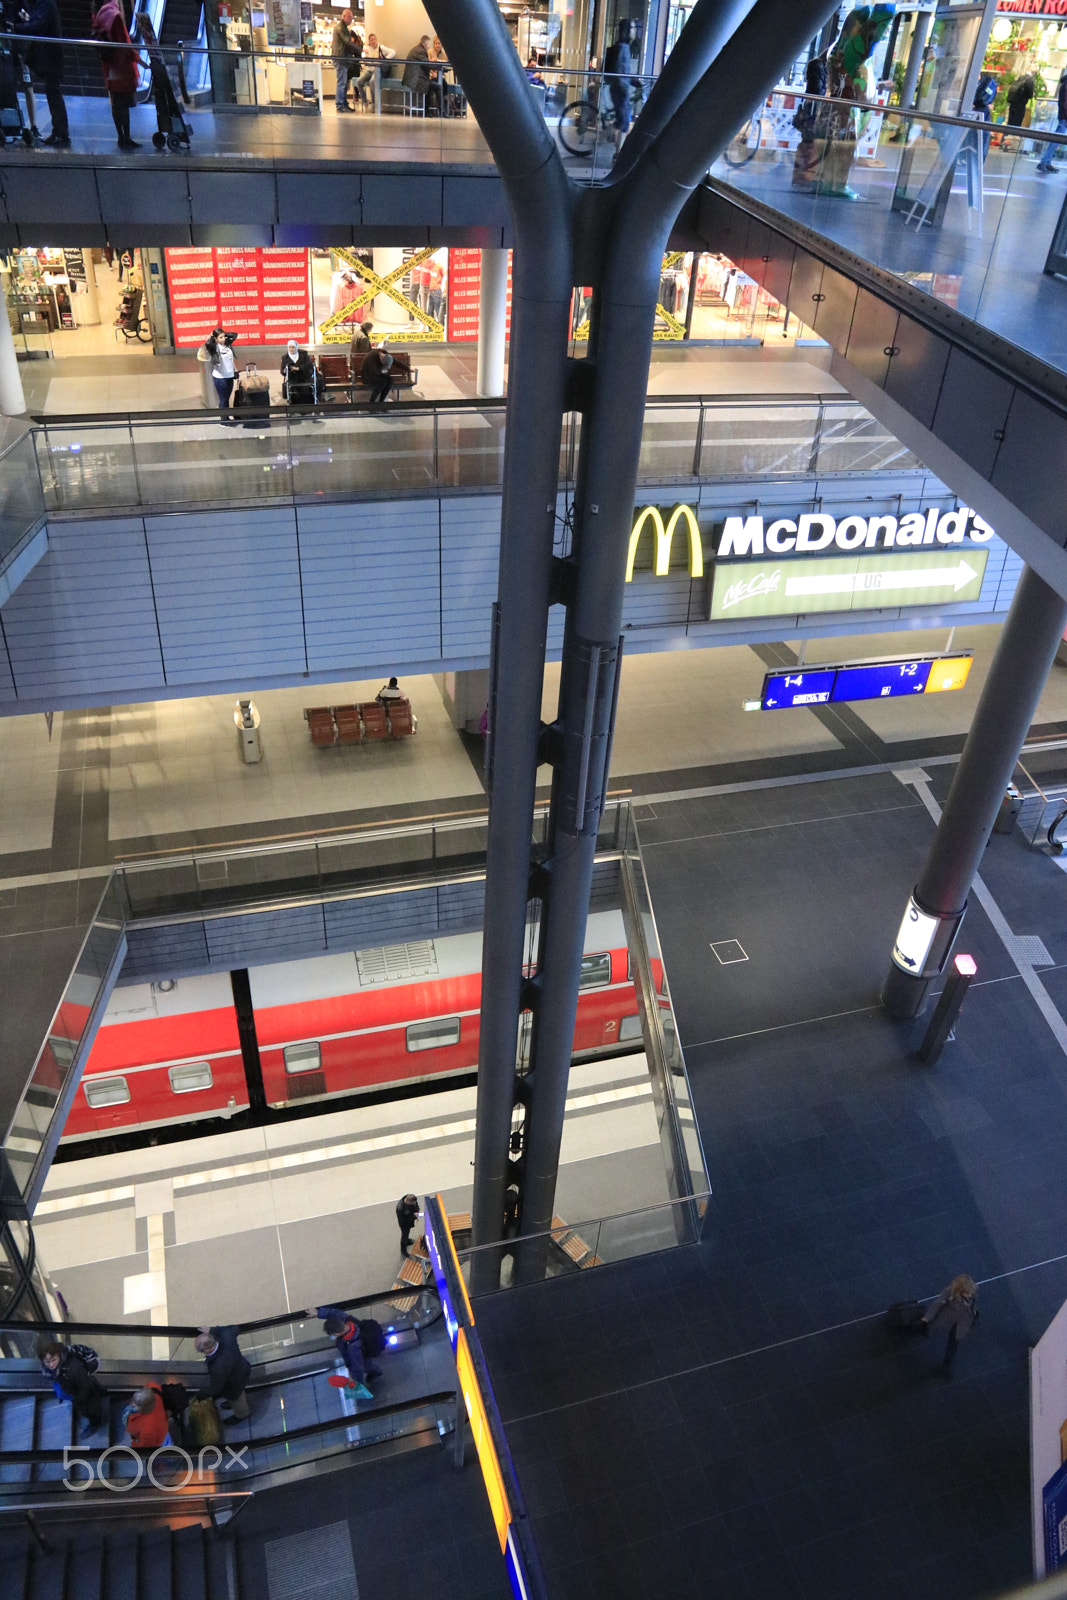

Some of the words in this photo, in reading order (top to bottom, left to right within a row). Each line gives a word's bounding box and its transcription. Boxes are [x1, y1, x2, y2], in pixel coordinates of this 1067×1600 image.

[996, 0, 1043, 13] LUMEN
[335, 248, 365, 272] CHLIESSEN!
[178, 334, 212, 343] RÄUMUNGSVER
[717, 507, 995, 556] McDonald's
[864, 574, 882, 589] UG
[900, 664, 918, 676] 1-2
[784, 675, 803, 688] 1-4
[605, 1020, 616, 1033] 2
